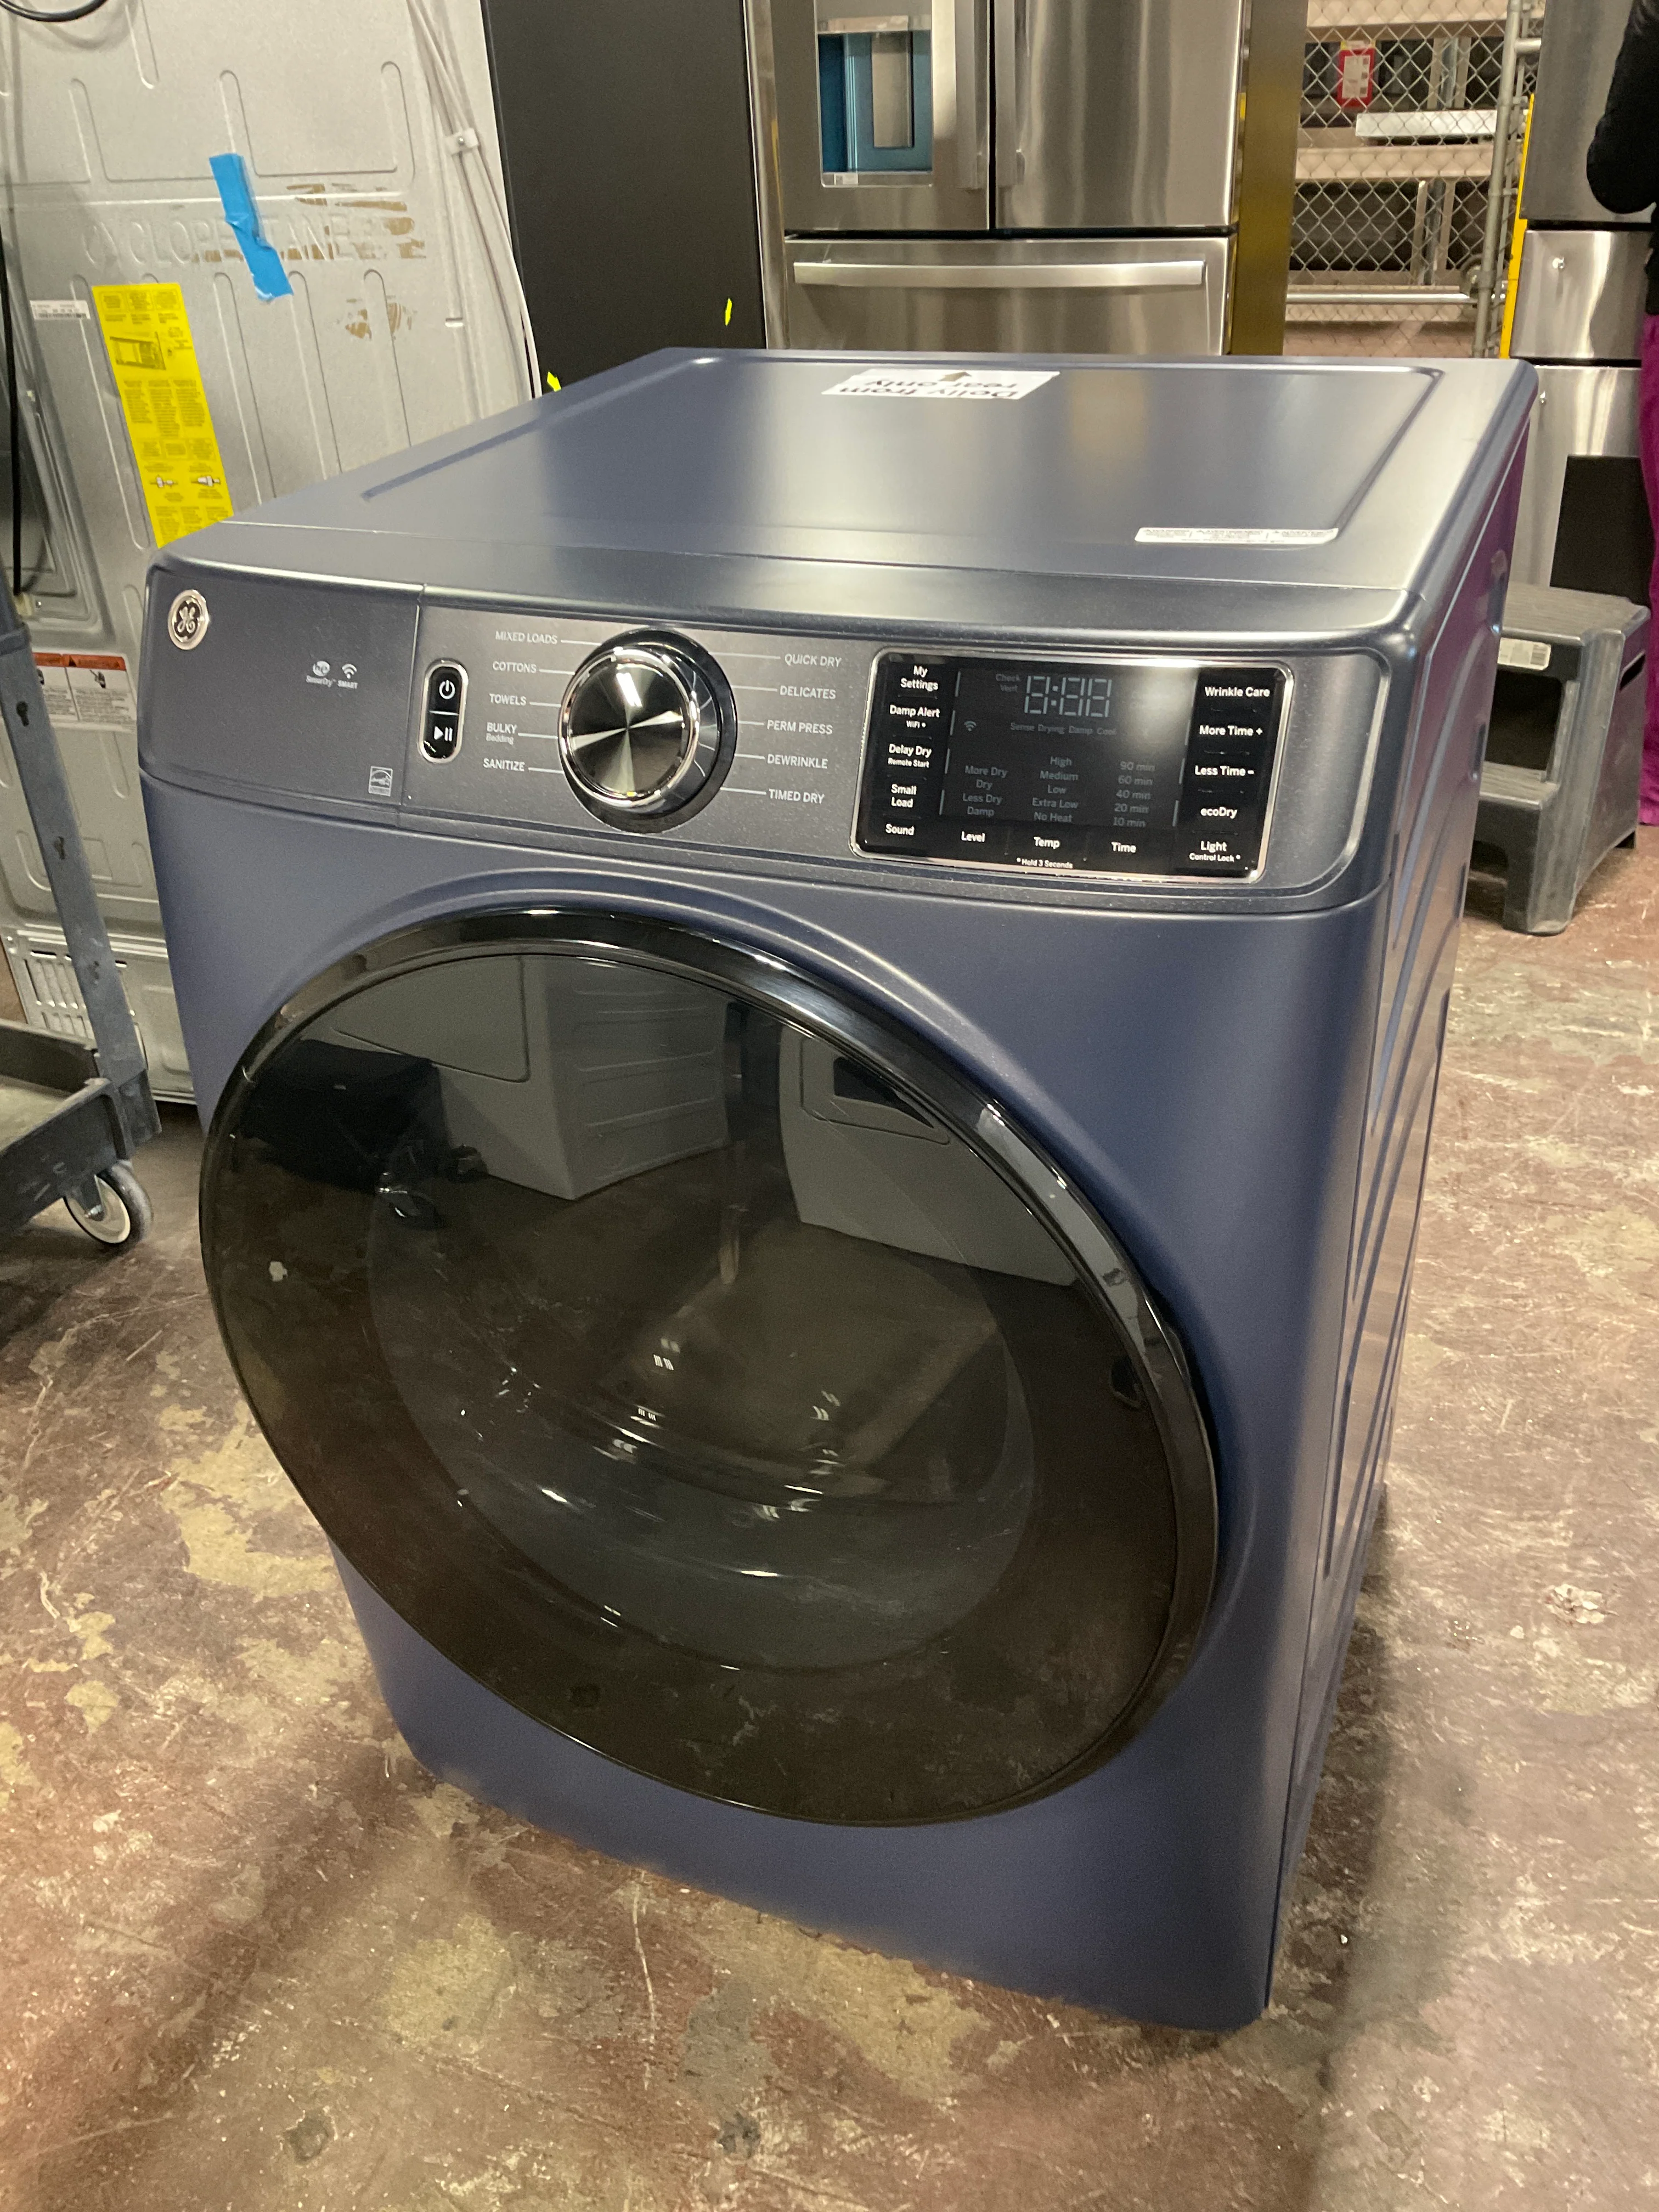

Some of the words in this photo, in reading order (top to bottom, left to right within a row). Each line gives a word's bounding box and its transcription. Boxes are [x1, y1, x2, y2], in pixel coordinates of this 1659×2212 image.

[864, 379, 938, 387] only
[926, 390, 1019, 398] Dolly
[495, 631, 524, 643] MIXED
[526, 633, 558, 645] LOADS
[784, 653, 817, 666] QUICK
[820, 655, 842, 667] DRY
[492, 661, 537, 673] COTTONS
[913, 665, 928, 677] My
[900, 679, 939, 691] Settings
[780, 685, 837, 700] DELICATES
[1204, 686, 1243, 697] Wrinkle
[1245, 687, 1270, 697] Care
[489, 693, 527, 706] TOWELS
[889, 704, 916, 716] Damp
[918, 707, 940, 718] Alert
[487, 722, 517, 733] BULKY
[767, 719, 797, 731] PERM
[799, 722, 833, 735] PRESS
[1199, 725, 1226, 736] More
[1227, 725, 1254, 736] Time
[486, 733, 514, 744] Bedding
[889, 743, 913, 757] Delay
[916, 745, 932, 758] Dry
[483, 758, 525, 771] SANITIZE
[767, 754, 828, 769] DEWRINKLE
[888, 757, 912, 766] Remote
[913, 759, 930, 768] Start
[1050, 757, 1073, 768] High
[1136, 763, 1155, 771] min
[965, 765, 988, 775] More
[990, 766, 1008, 778] Dry
[1040, 770, 1079, 781] Medium
[1195, 765, 1218, 776] Less
[1220, 766, 1246, 776] Time
[976, 779, 993, 791] Dry
[1118, 776, 1132, 785] 60
[1134, 777, 1153, 786] min
[891, 783, 917, 795] Small
[1047, 785, 1066, 794] Low
[1116, 789, 1130, 799] 40
[1132, 791, 1152, 800] min
[769, 788, 799, 801] TIMED
[802, 791, 825, 804] DRY
[962, 793, 984, 803] Less
[985, 794, 1003, 805] Dry
[891, 797, 913, 808] Load
[1032, 797, 1057, 808] Extra
[1059, 799, 1079, 809] Low
[967, 806, 995, 817] Damp
[1114, 804, 1128, 812] 20
[1130, 805, 1149, 814] min
[1200, 807, 1238, 820] ecoDry
[1034, 812, 1048, 821] No
[1049, 813, 1073, 823] Heat
[1113, 817, 1125, 826] 10
[1127, 819, 1146, 827] min
[885, 823, 915, 836] Sound
[961, 831, 985, 842] Level
[1034, 836, 1060, 849] Temp
[1111, 842, 1137, 853] Time
[1200, 840, 1227, 853] Light
[1189, 853, 1216, 862] Control
[1217, 854, 1235, 862] Lock
[1022, 858, 1037, 867] Hold
[1044, 860, 1073, 869] Seconds
